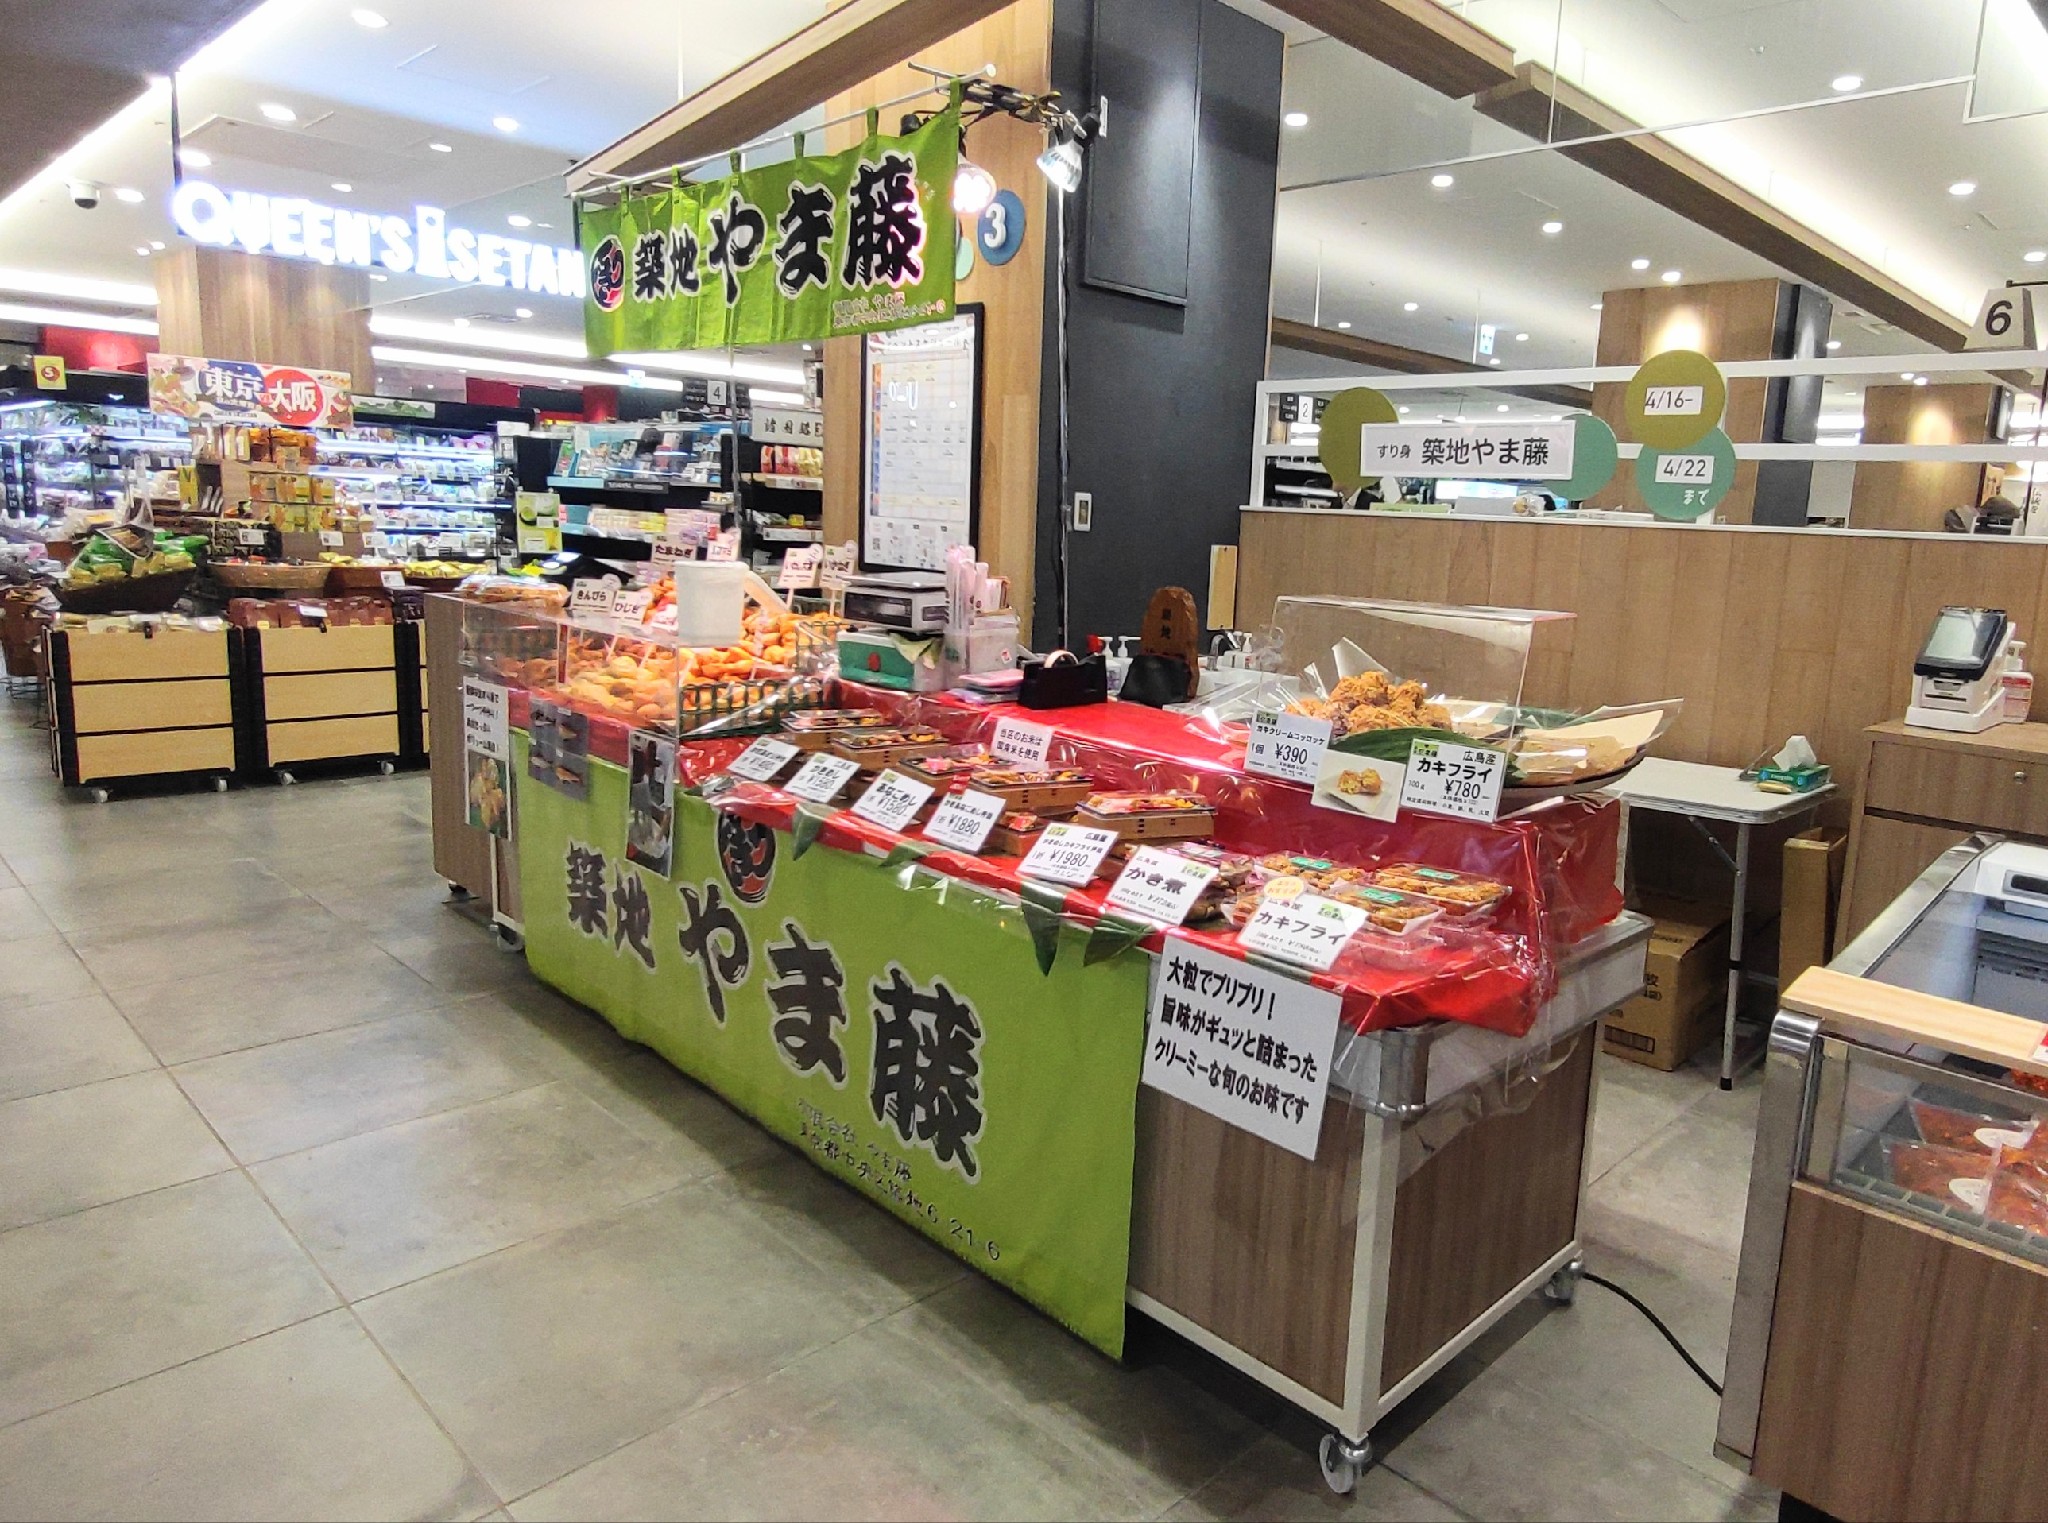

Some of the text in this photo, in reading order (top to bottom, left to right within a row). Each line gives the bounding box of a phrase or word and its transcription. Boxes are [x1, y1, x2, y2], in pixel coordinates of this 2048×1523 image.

[634, 154, 922, 302] 築地やま藤
[984, 202, 1006, 248] 3
[172, 181, 587, 299] QUEEN'S ISETAN
[1985, 300, 2013, 336] 6
[205, 366, 264, 401] 東京
[268, 380, 317, 413] 大阪
[713, 386, 721, 401] 4
[1302, 402, 1309, 418] 2
[1376, 436, 1550, 466] すり身 築地やま藤
[1663, 459, 1706, 478] 4/22
[1683, 488, 1709, 506] まで
[655, 544, 694, 558] たまねぎ
[614, 601, 642, 614] ひじき
[1275, 742, 1308, 765] ¥390
[1463, 750, 1497, 766] 広島産
[1416, 757, 1493, 784] カキフライ
[1444, 778, 1481, 800] ¥780
[948, 813, 981, 835] ¥1880
[1049, 849, 1089, 867] ¥1980
[1125, 866, 1188, 895] かき煮
[1255, 911, 1347, 945] カキフライ
[566, 841, 983, 1178] 築地やま藤
[1160, 993, 1318, 1083] 旨味がギュッと詰まった
[1154, 1035, 1310, 1125] クリーミーな旬のお味です
